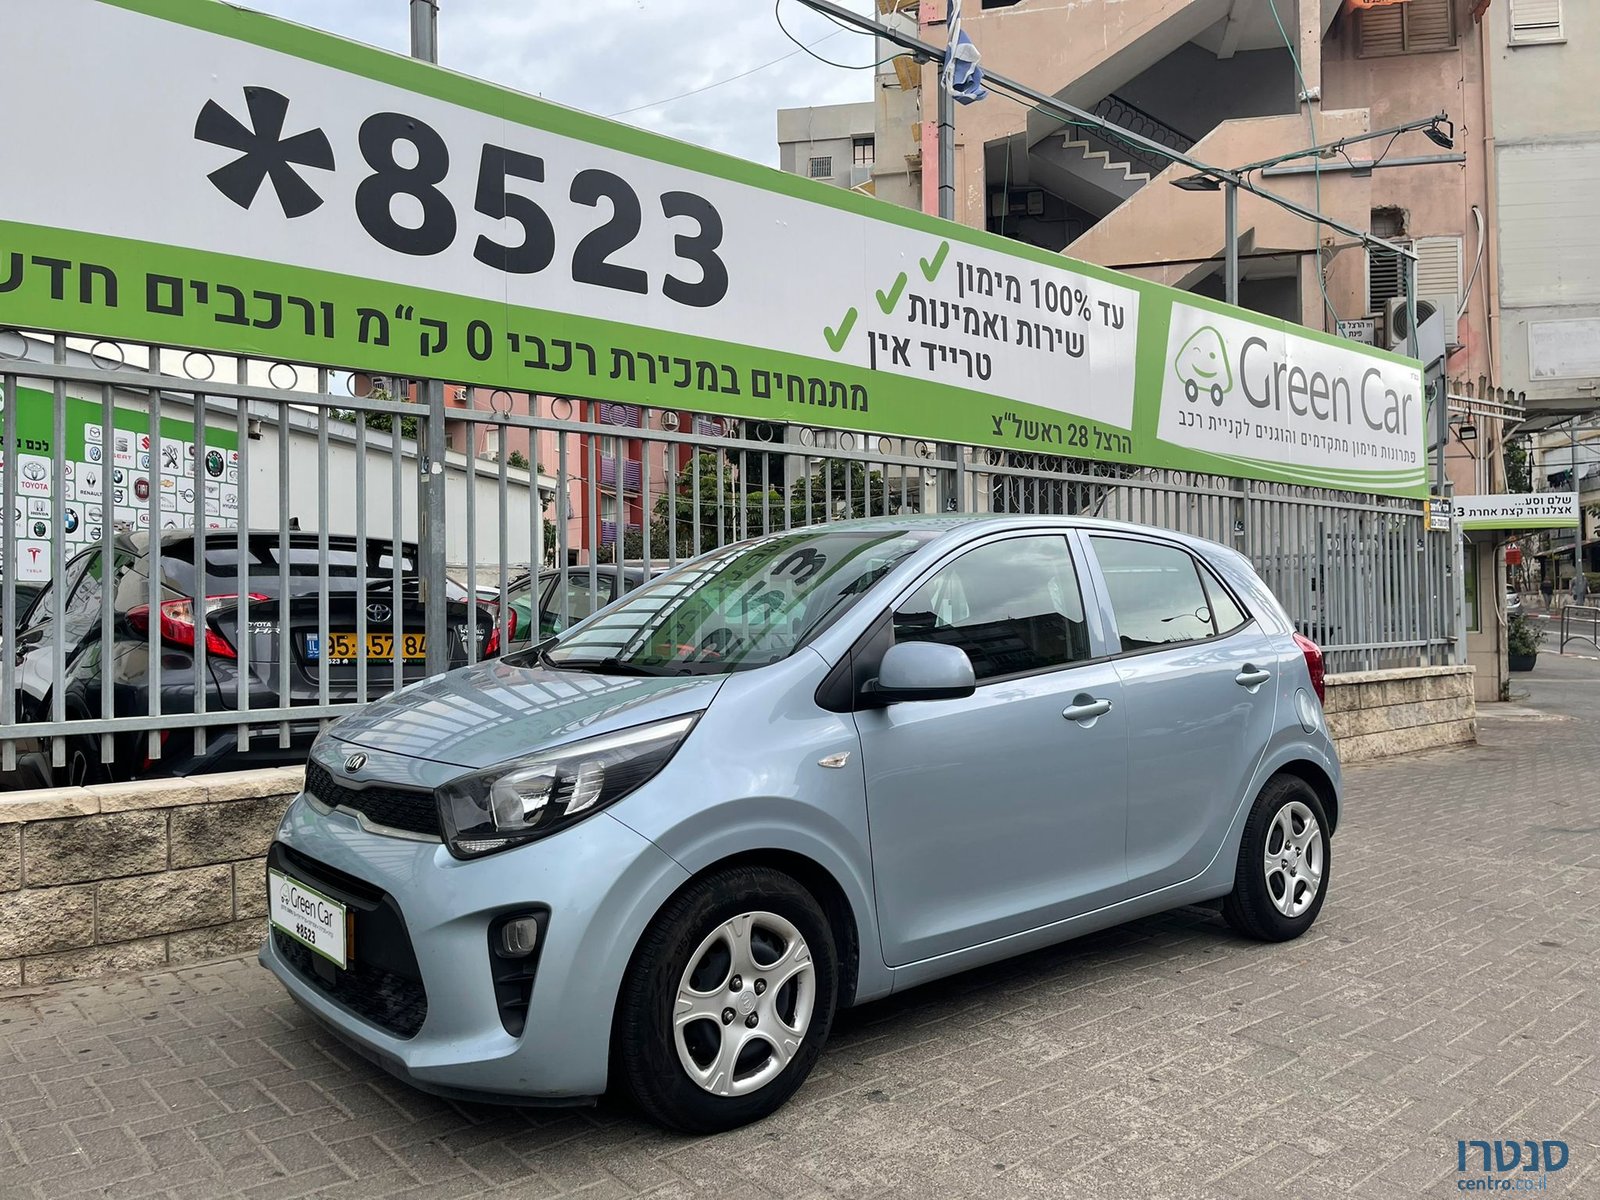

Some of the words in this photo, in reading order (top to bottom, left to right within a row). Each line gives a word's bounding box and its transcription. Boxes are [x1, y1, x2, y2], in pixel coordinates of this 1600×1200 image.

[956, 261, 1022, 304] מימון
[146, 272, 335, 339] ורכבים
[1030, 278, 1092, 322] 100%
[908, 293, 1008, 343] ואמינות
[1098, 300, 1125, 330] עד
[466, 319, 493, 361] 0
[867, 330, 911, 370] אין
[1016, 318, 1085, 358] שירות
[507, 332, 597, 376] רכבי
[920, 340, 992, 381] טרייד
[609, 347, 741, 396] במכירת
[751, 368, 869, 413] מתמחים
[1240, 336, 1352, 425] Green
[1360, 367, 1412, 436] Car
[1178, 410, 1203, 429] רכב
[1208, 415, 1250, 440] לקניית
[26, 439, 49, 452] לכם
[1067, 423, 1089, 448] 28
[1093, 426, 1132, 454] הרצל
[1255, 424, 1296, 445] והוגנים
[1300, 432, 1348, 454] מתקדמים
[1352, 440, 1377, 460] מימון
[1381, 444, 1416, 464] פתרונות
[21, 481, 48, 491] TOYOTA
[1547, 495, 1572, 505] שלם
[1468, 508, 1498, 517] אחרת
[1501, 507, 1523, 518] קצת
[1527, 506, 1539, 515] זה
[1542, 505, 1572, 515] אצלנו
[290, 887, 316, 919] Green
[317, 901, 333, 928] Car
